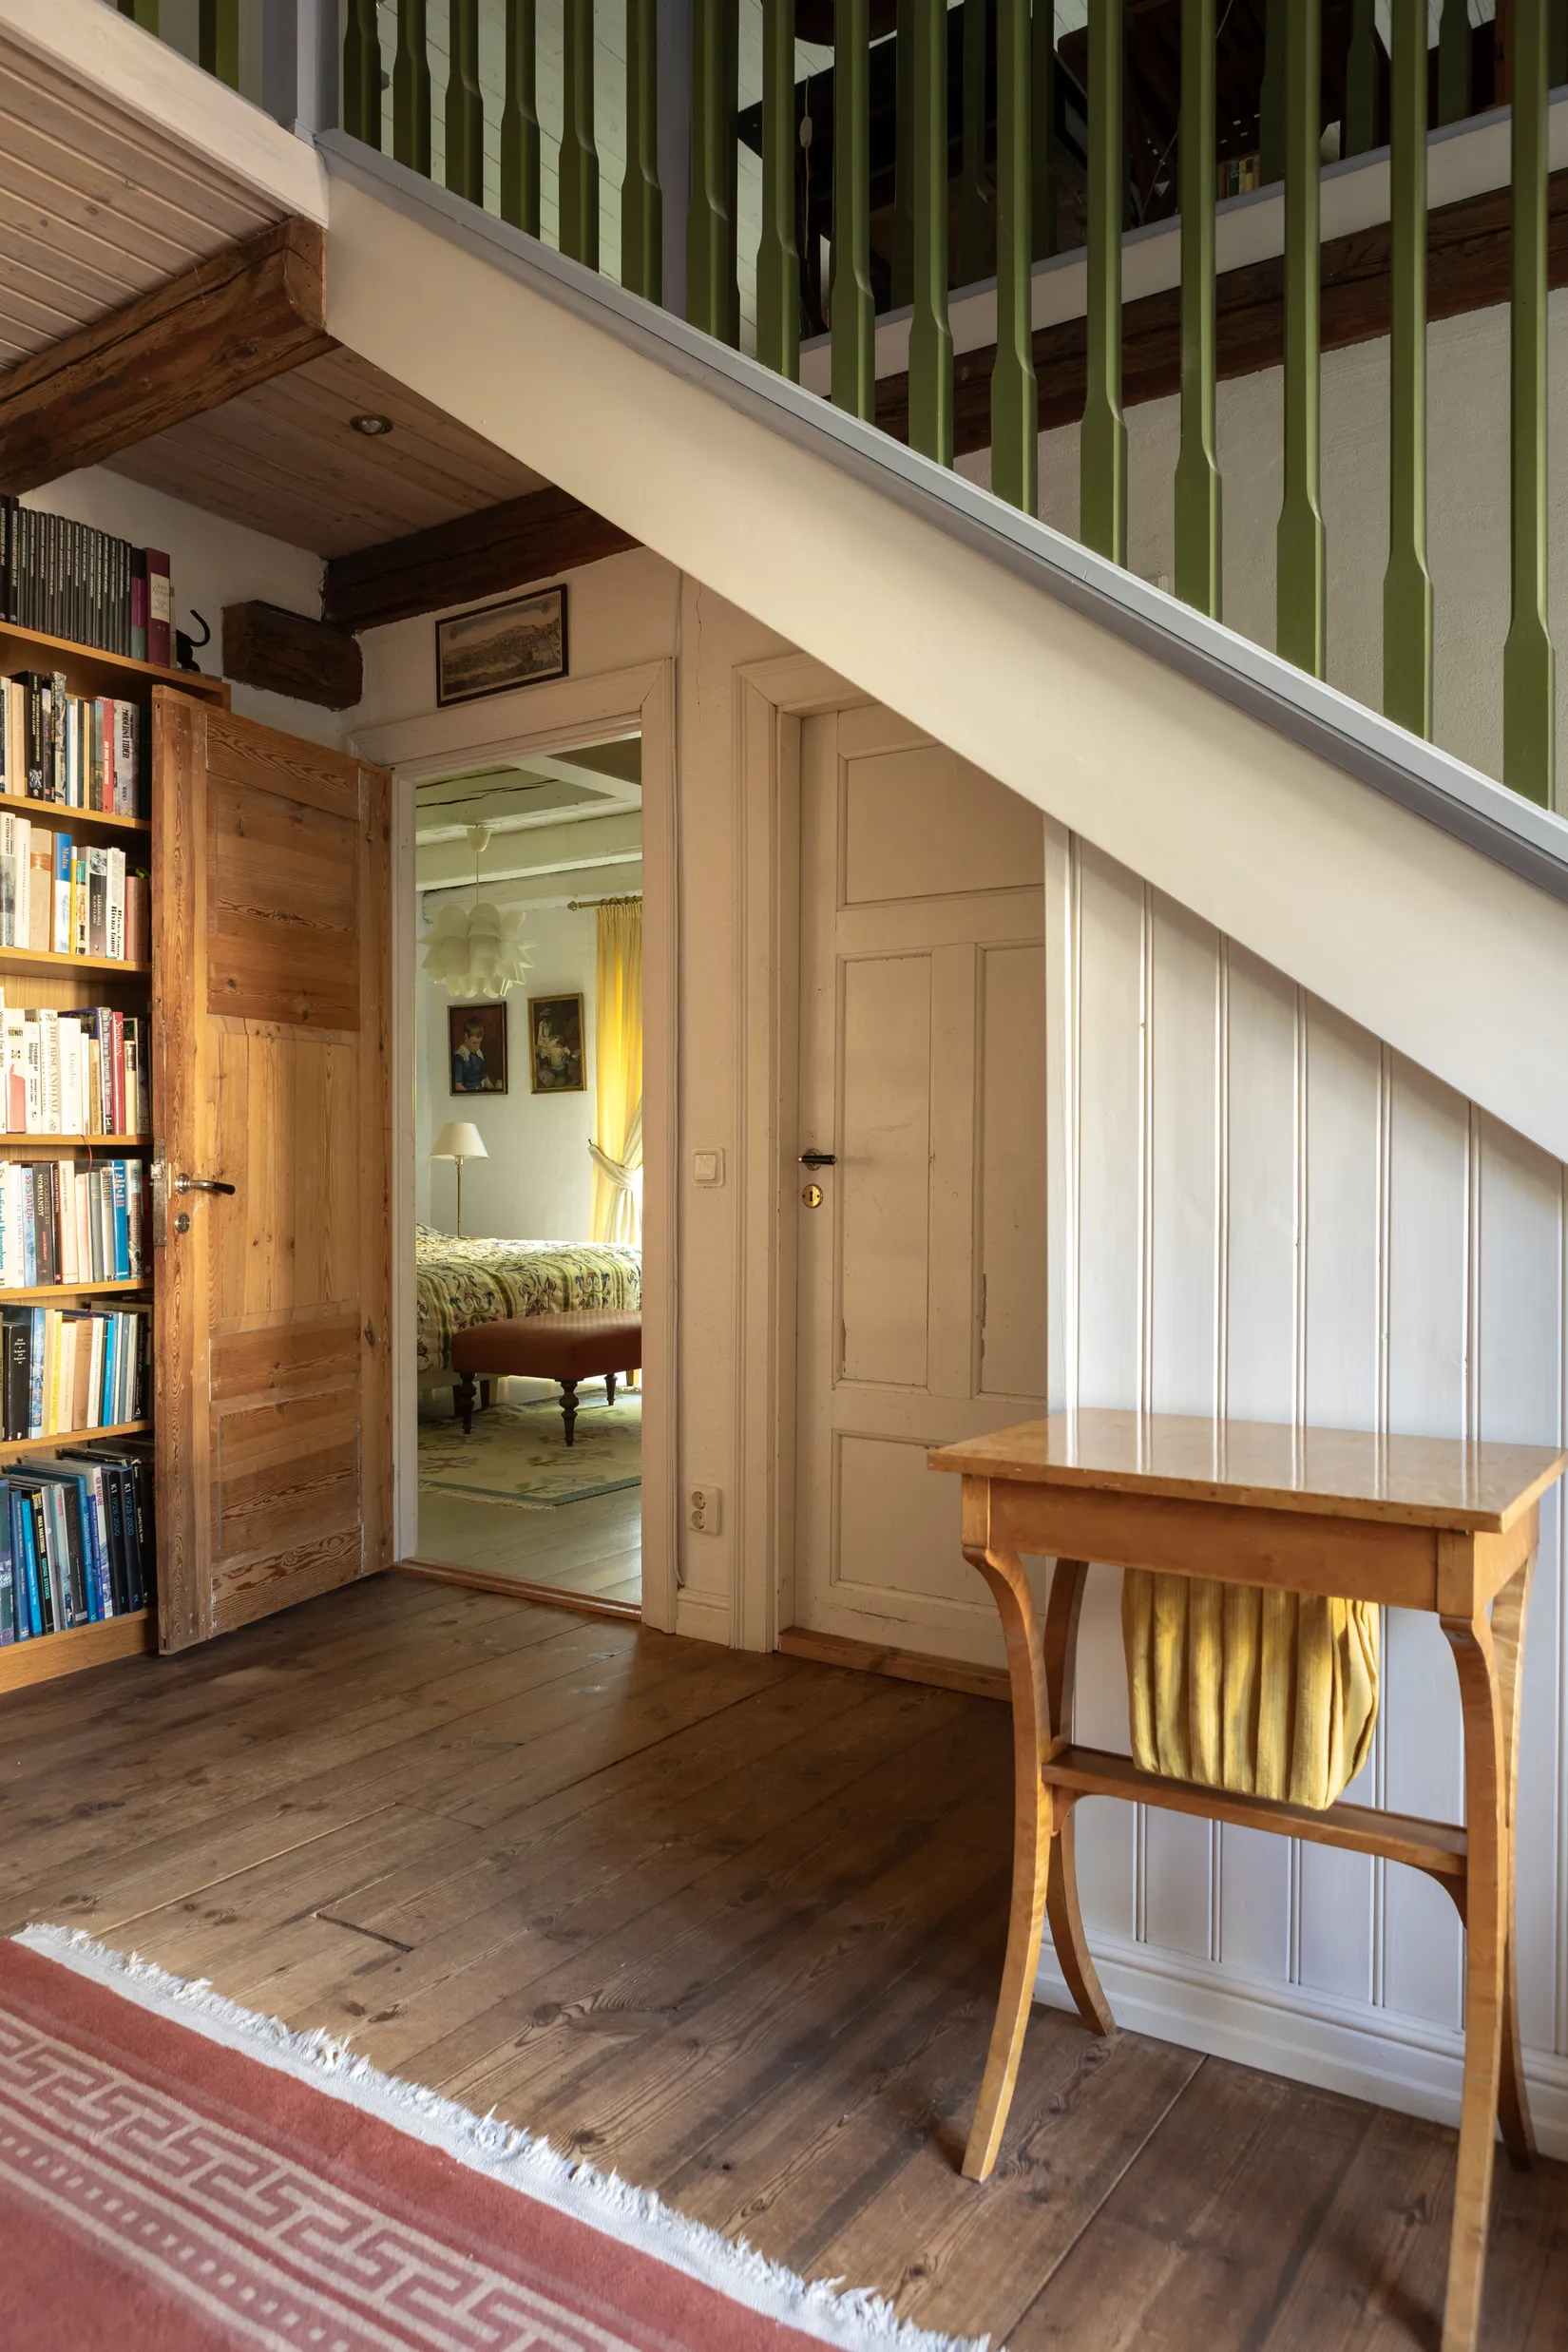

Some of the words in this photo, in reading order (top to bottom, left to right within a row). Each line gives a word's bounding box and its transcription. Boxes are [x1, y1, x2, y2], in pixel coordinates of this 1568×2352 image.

[115, 1021, 124, 1057] SPANIEN
[110, 1483, 118, 1493] K1
[124, 1483, 131, 1493] K1
